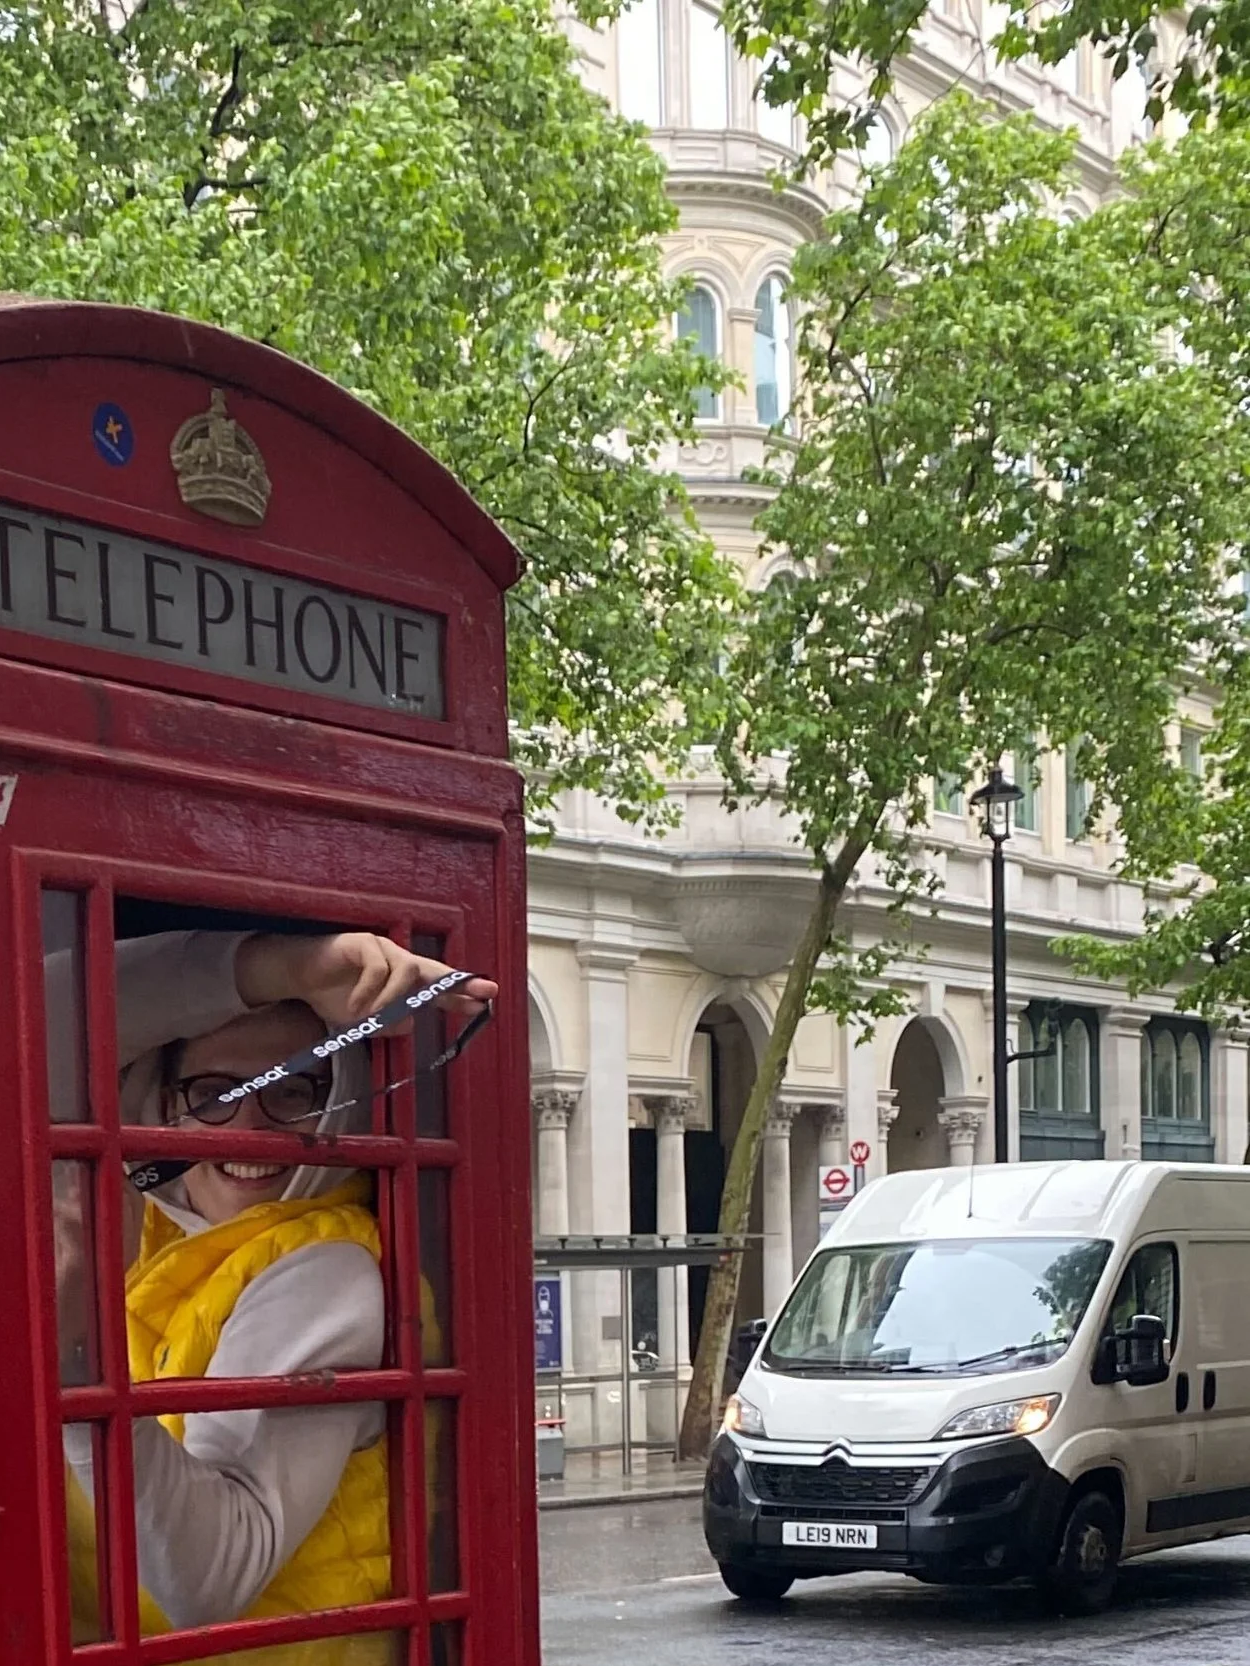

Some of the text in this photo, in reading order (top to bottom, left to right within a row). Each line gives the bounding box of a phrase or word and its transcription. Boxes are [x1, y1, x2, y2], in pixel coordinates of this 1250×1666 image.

[218, 970, 472, 1103] sensat sensat sensa
[851, 1144, 869, 1161] W
[796, 1526, 867, 1544] LE19 NRN
